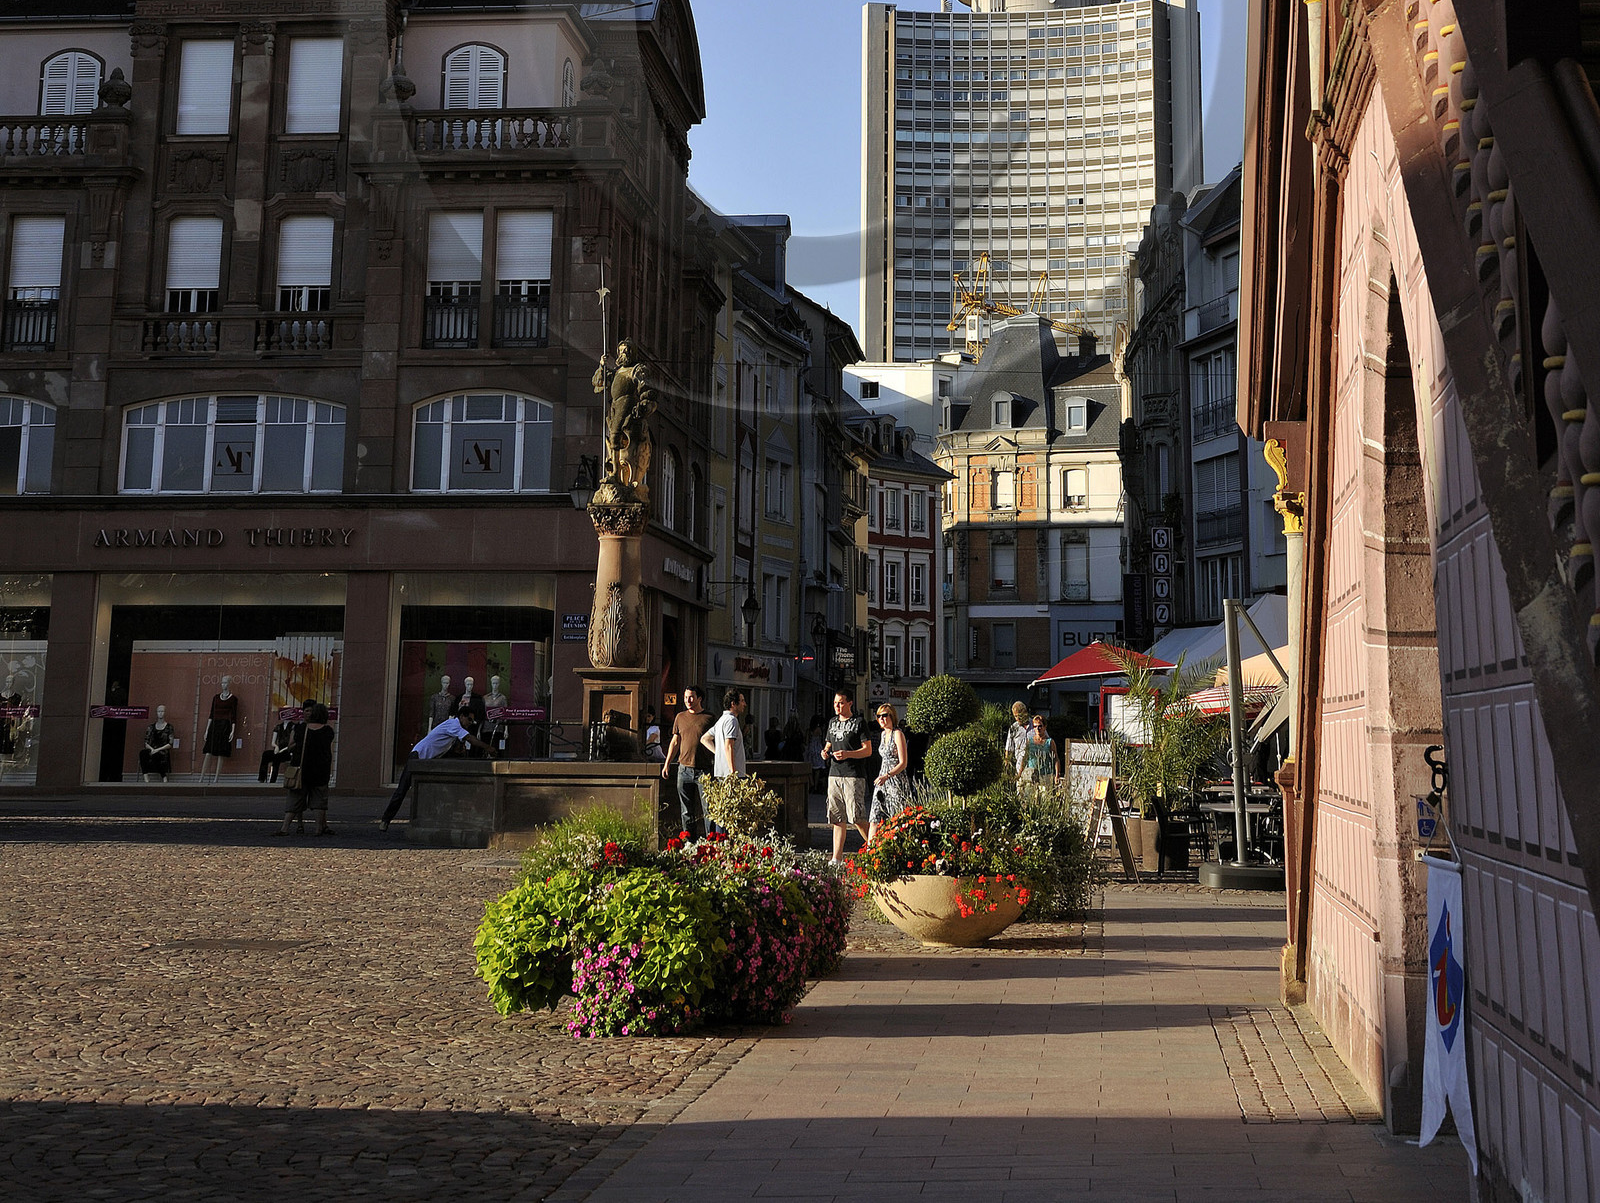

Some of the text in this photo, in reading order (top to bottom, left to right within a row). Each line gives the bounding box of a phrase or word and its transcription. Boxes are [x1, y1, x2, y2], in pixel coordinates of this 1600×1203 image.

[94, 528, 356, 548] ARMAND THIERY
[207, 654, 263, 667] nouvelle
